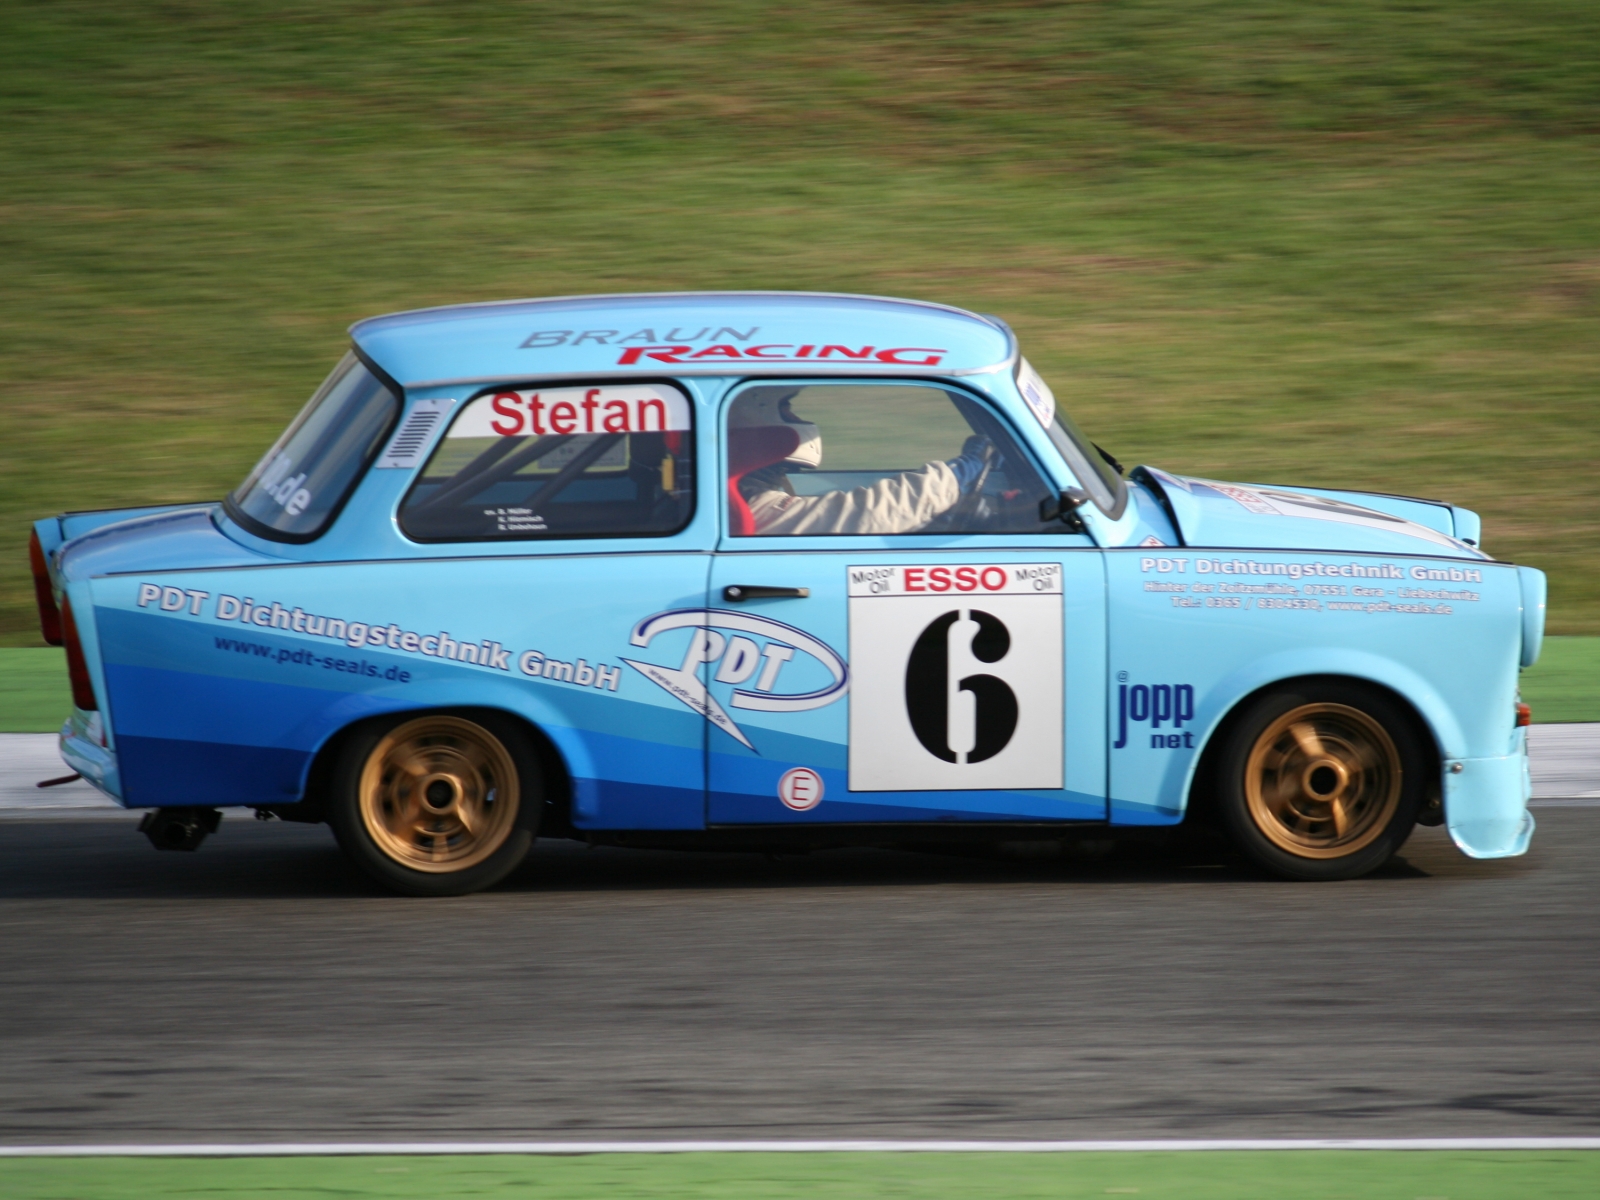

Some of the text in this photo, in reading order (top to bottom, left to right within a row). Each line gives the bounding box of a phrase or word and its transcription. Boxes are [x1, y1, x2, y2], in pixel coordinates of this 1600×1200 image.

[517, 326, 762, 349] BRAUN
[616, 344, 949, 366] RACING
[490, 388, 667, 436] Stefan
[851, 564, 1059, 592] Motor ESSO Motor
[1140, 557, 1483, 583] PDT Dichtungstechnik GmbH
[868, 578, 1055, 594] Oil Oil
[1144, 581, 1188, 593] Hinter
[1192, 582, 1215, 593] der
[1303, 584, 1348, 596] 07551
[1352, 585, 1385, 598] Gera
[1398, 587, 1481, 602] Liebschwitz
[1205, 597, 1242, 608] 0365
[1327, 600, 1453, 615] www.pdt-seals.de
[137, 582, 622, 692] PDT Dichtungstechnik GmbH
[213, 636, 411, 683] www.pdt-seals.de
[680, 626, 795, 692] PDT
[905, 609, 1019, 764] 6
[1113, 683, 1194, 749] jopp
[1150, 731, 1195, 749] net
[790, 776, 811, 801] E
